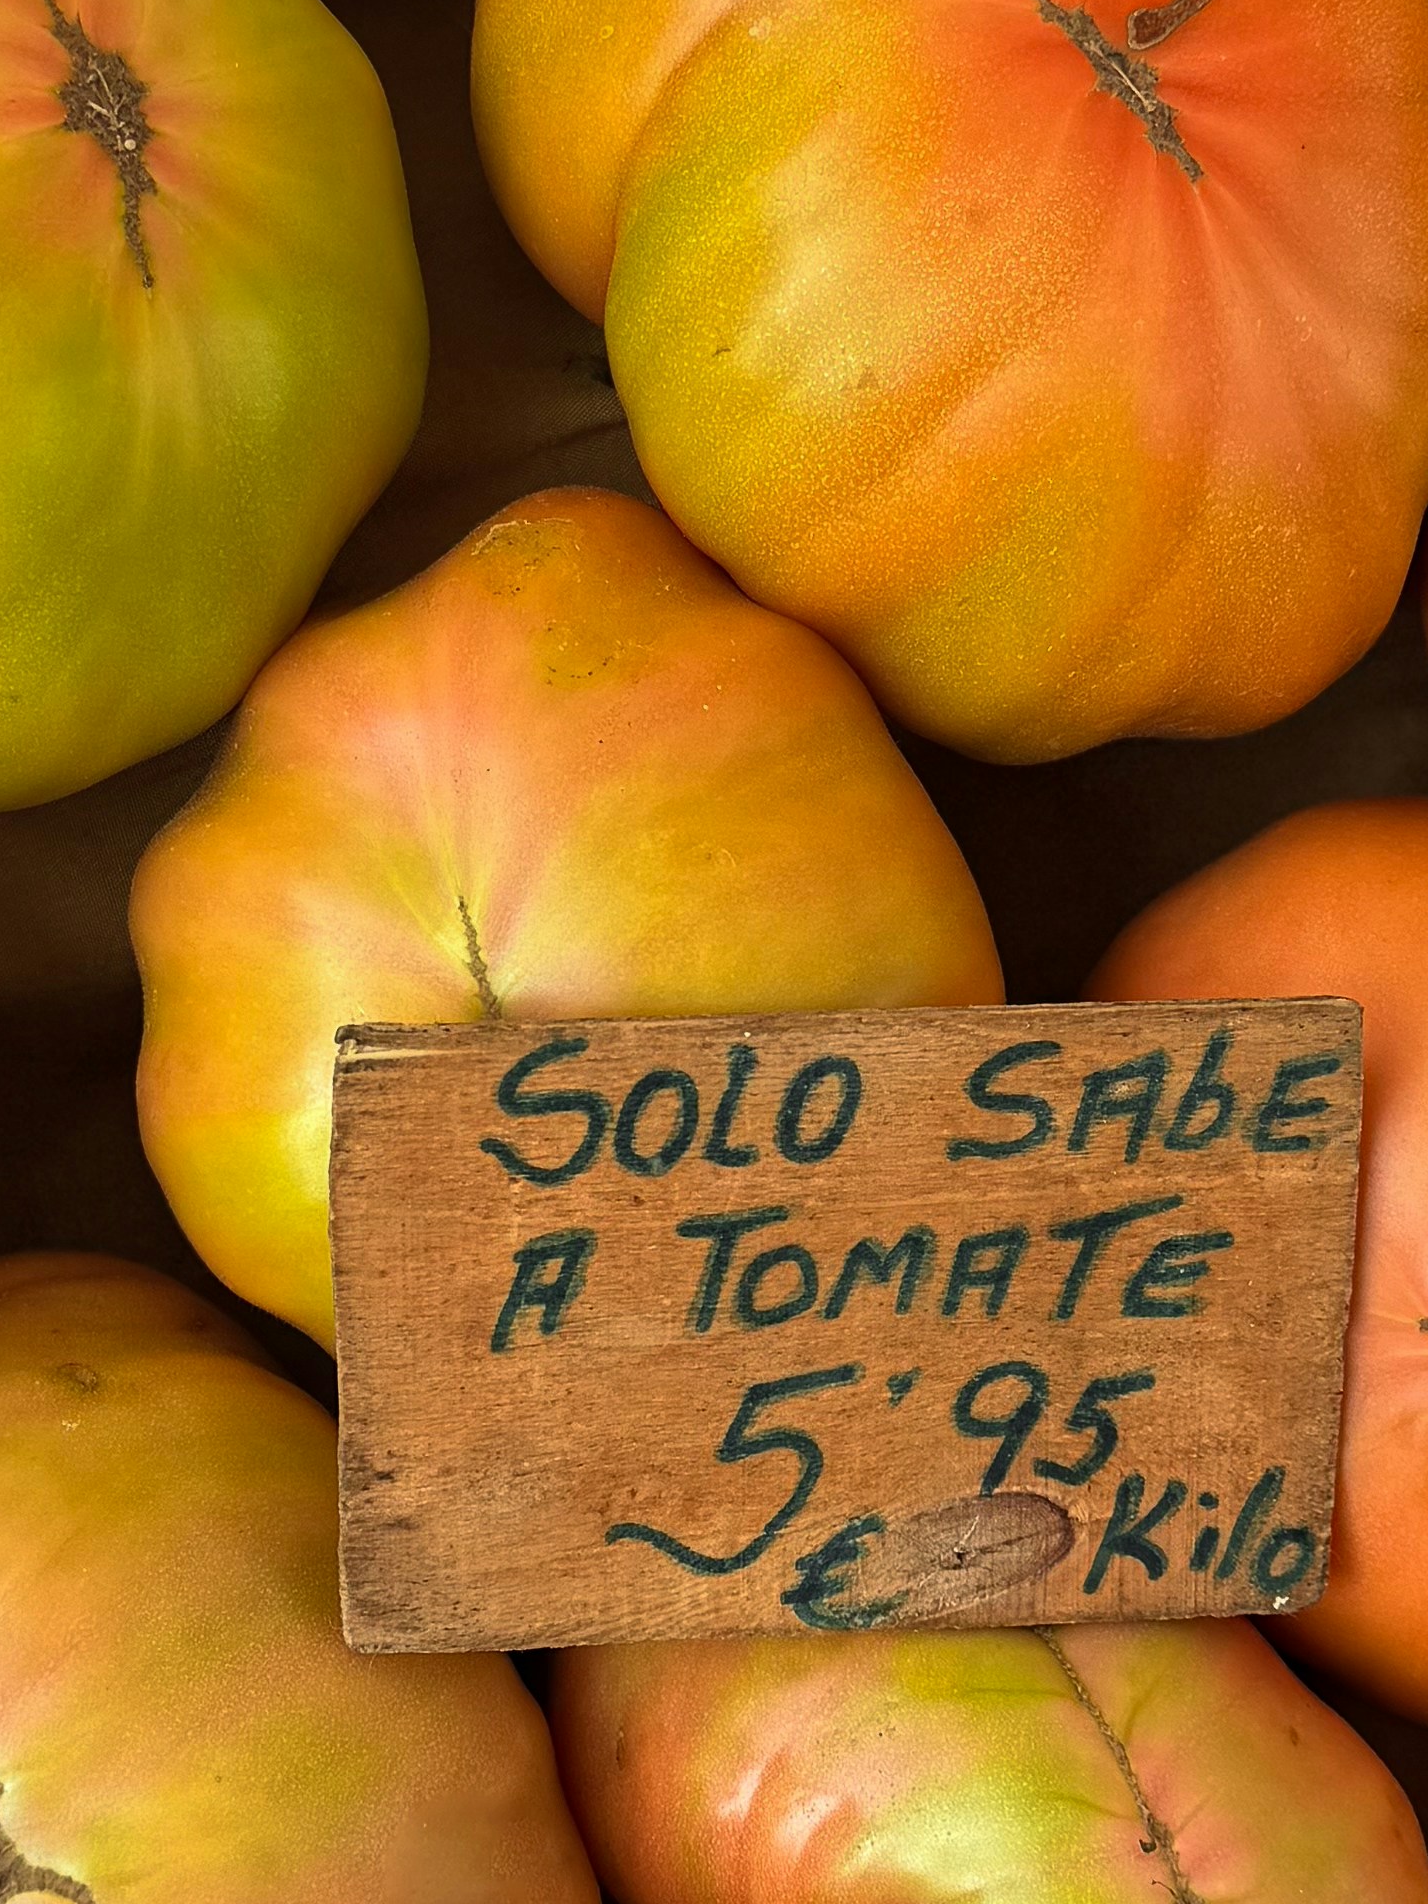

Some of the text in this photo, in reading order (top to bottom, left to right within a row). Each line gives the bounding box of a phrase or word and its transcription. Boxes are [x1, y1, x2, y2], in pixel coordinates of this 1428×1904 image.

[491, 1195, 1233, 1352] A TOMATE
[604, 1360, 1156, 1577] 5'95
[781, 1467, 1316, 1631] € Kilo
